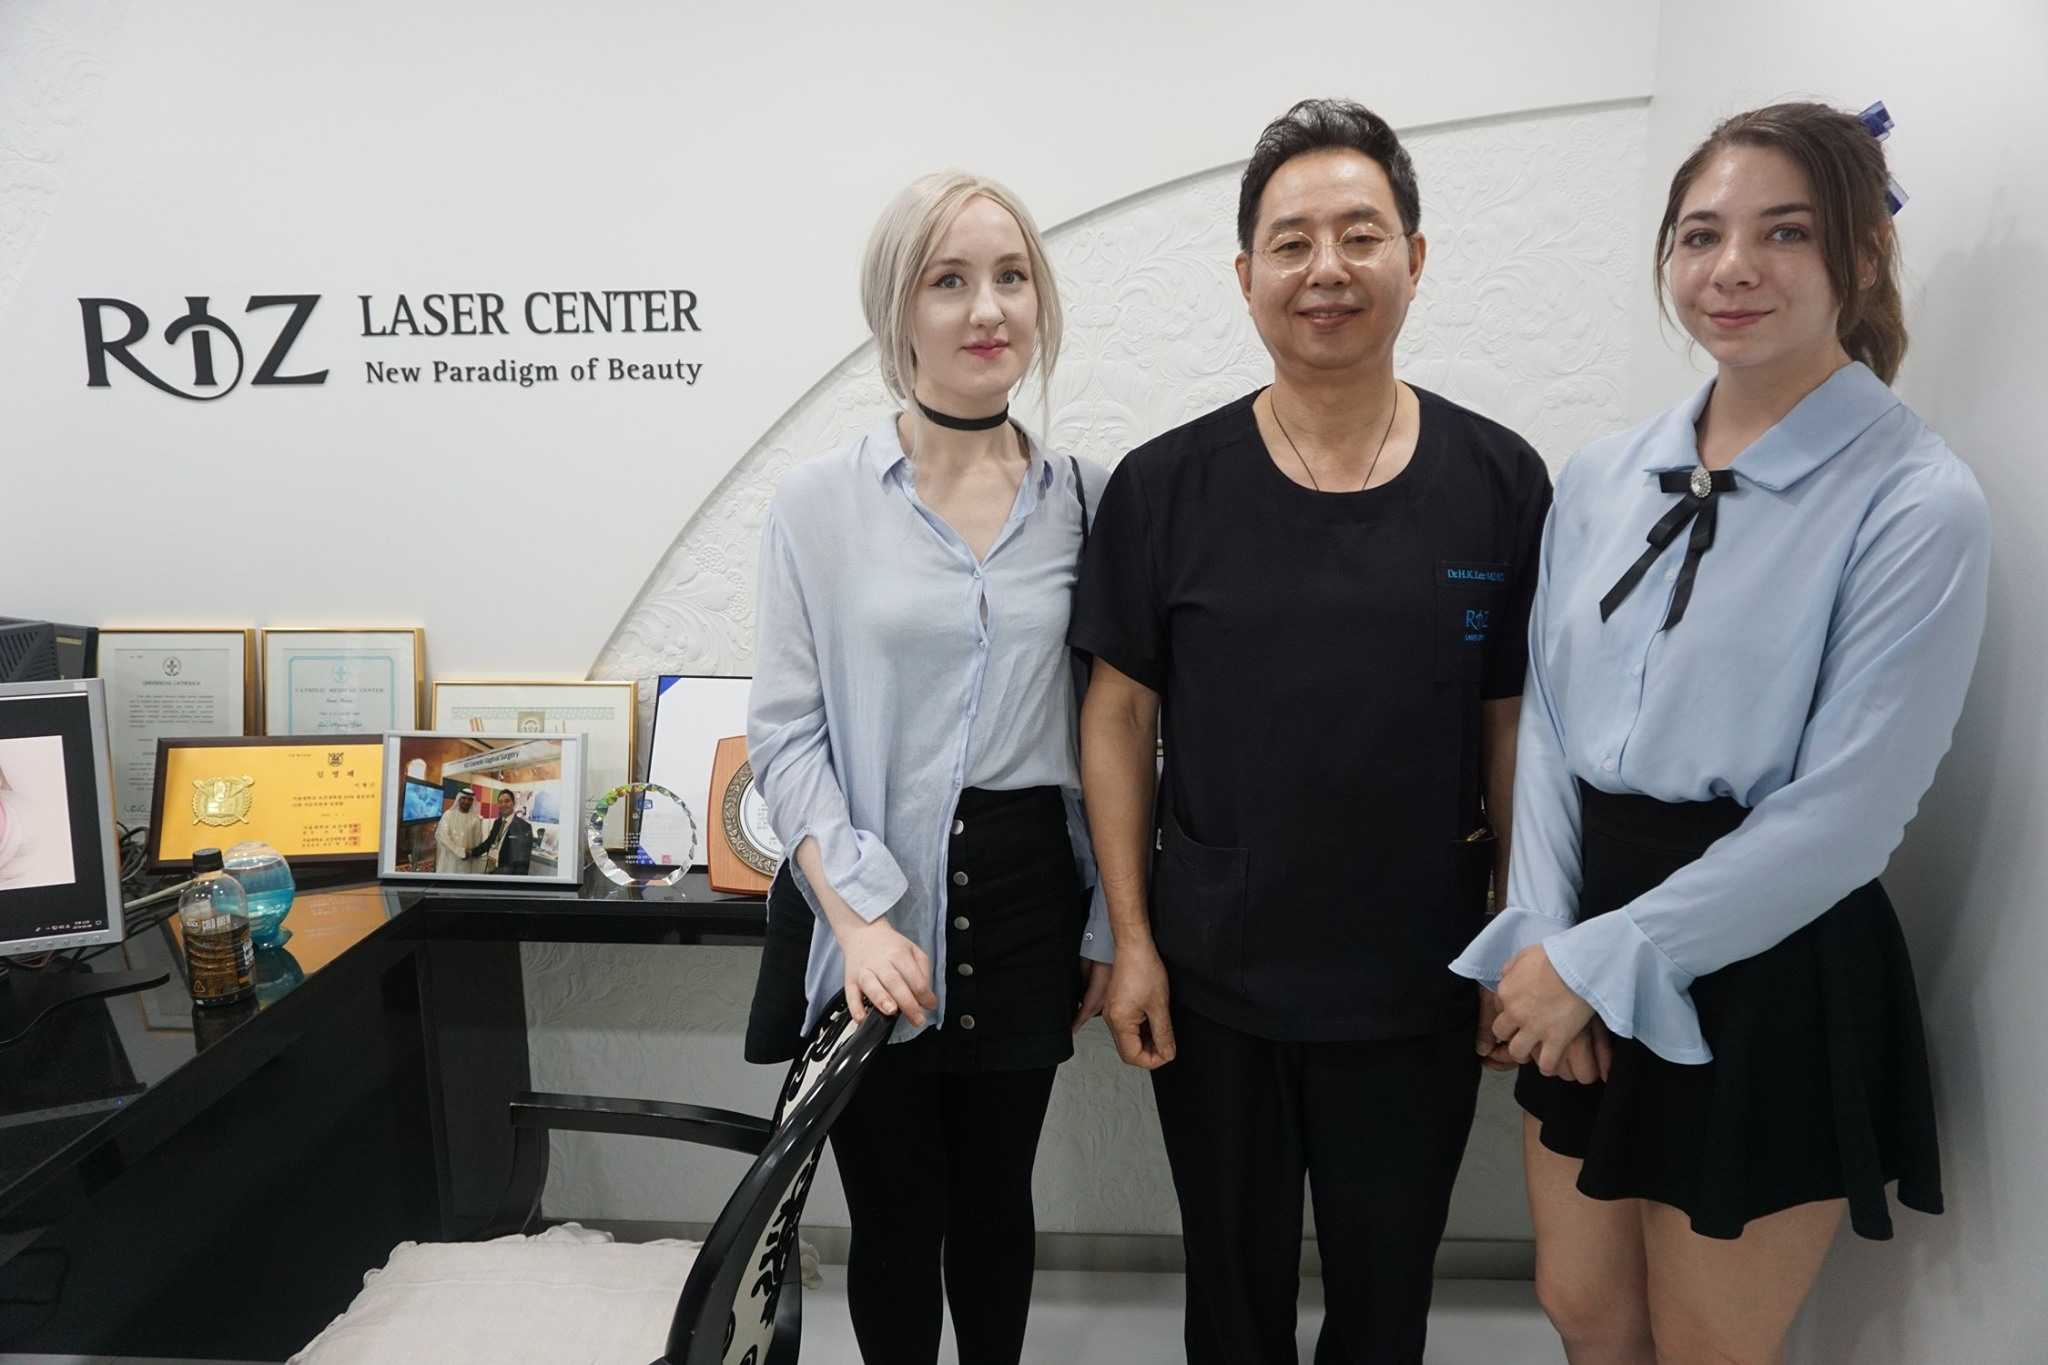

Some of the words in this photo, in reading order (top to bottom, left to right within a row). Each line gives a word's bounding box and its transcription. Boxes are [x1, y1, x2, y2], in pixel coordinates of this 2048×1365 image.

[359, 293, 509, 337] LASER
[525, 290, 702, 335] CENTER
[366, 361, 421, 384] New
[433, 360, 559, 388] Paradigm
[570, 358, 600, 381] of
[608, 359, 703, 386] Beauty
